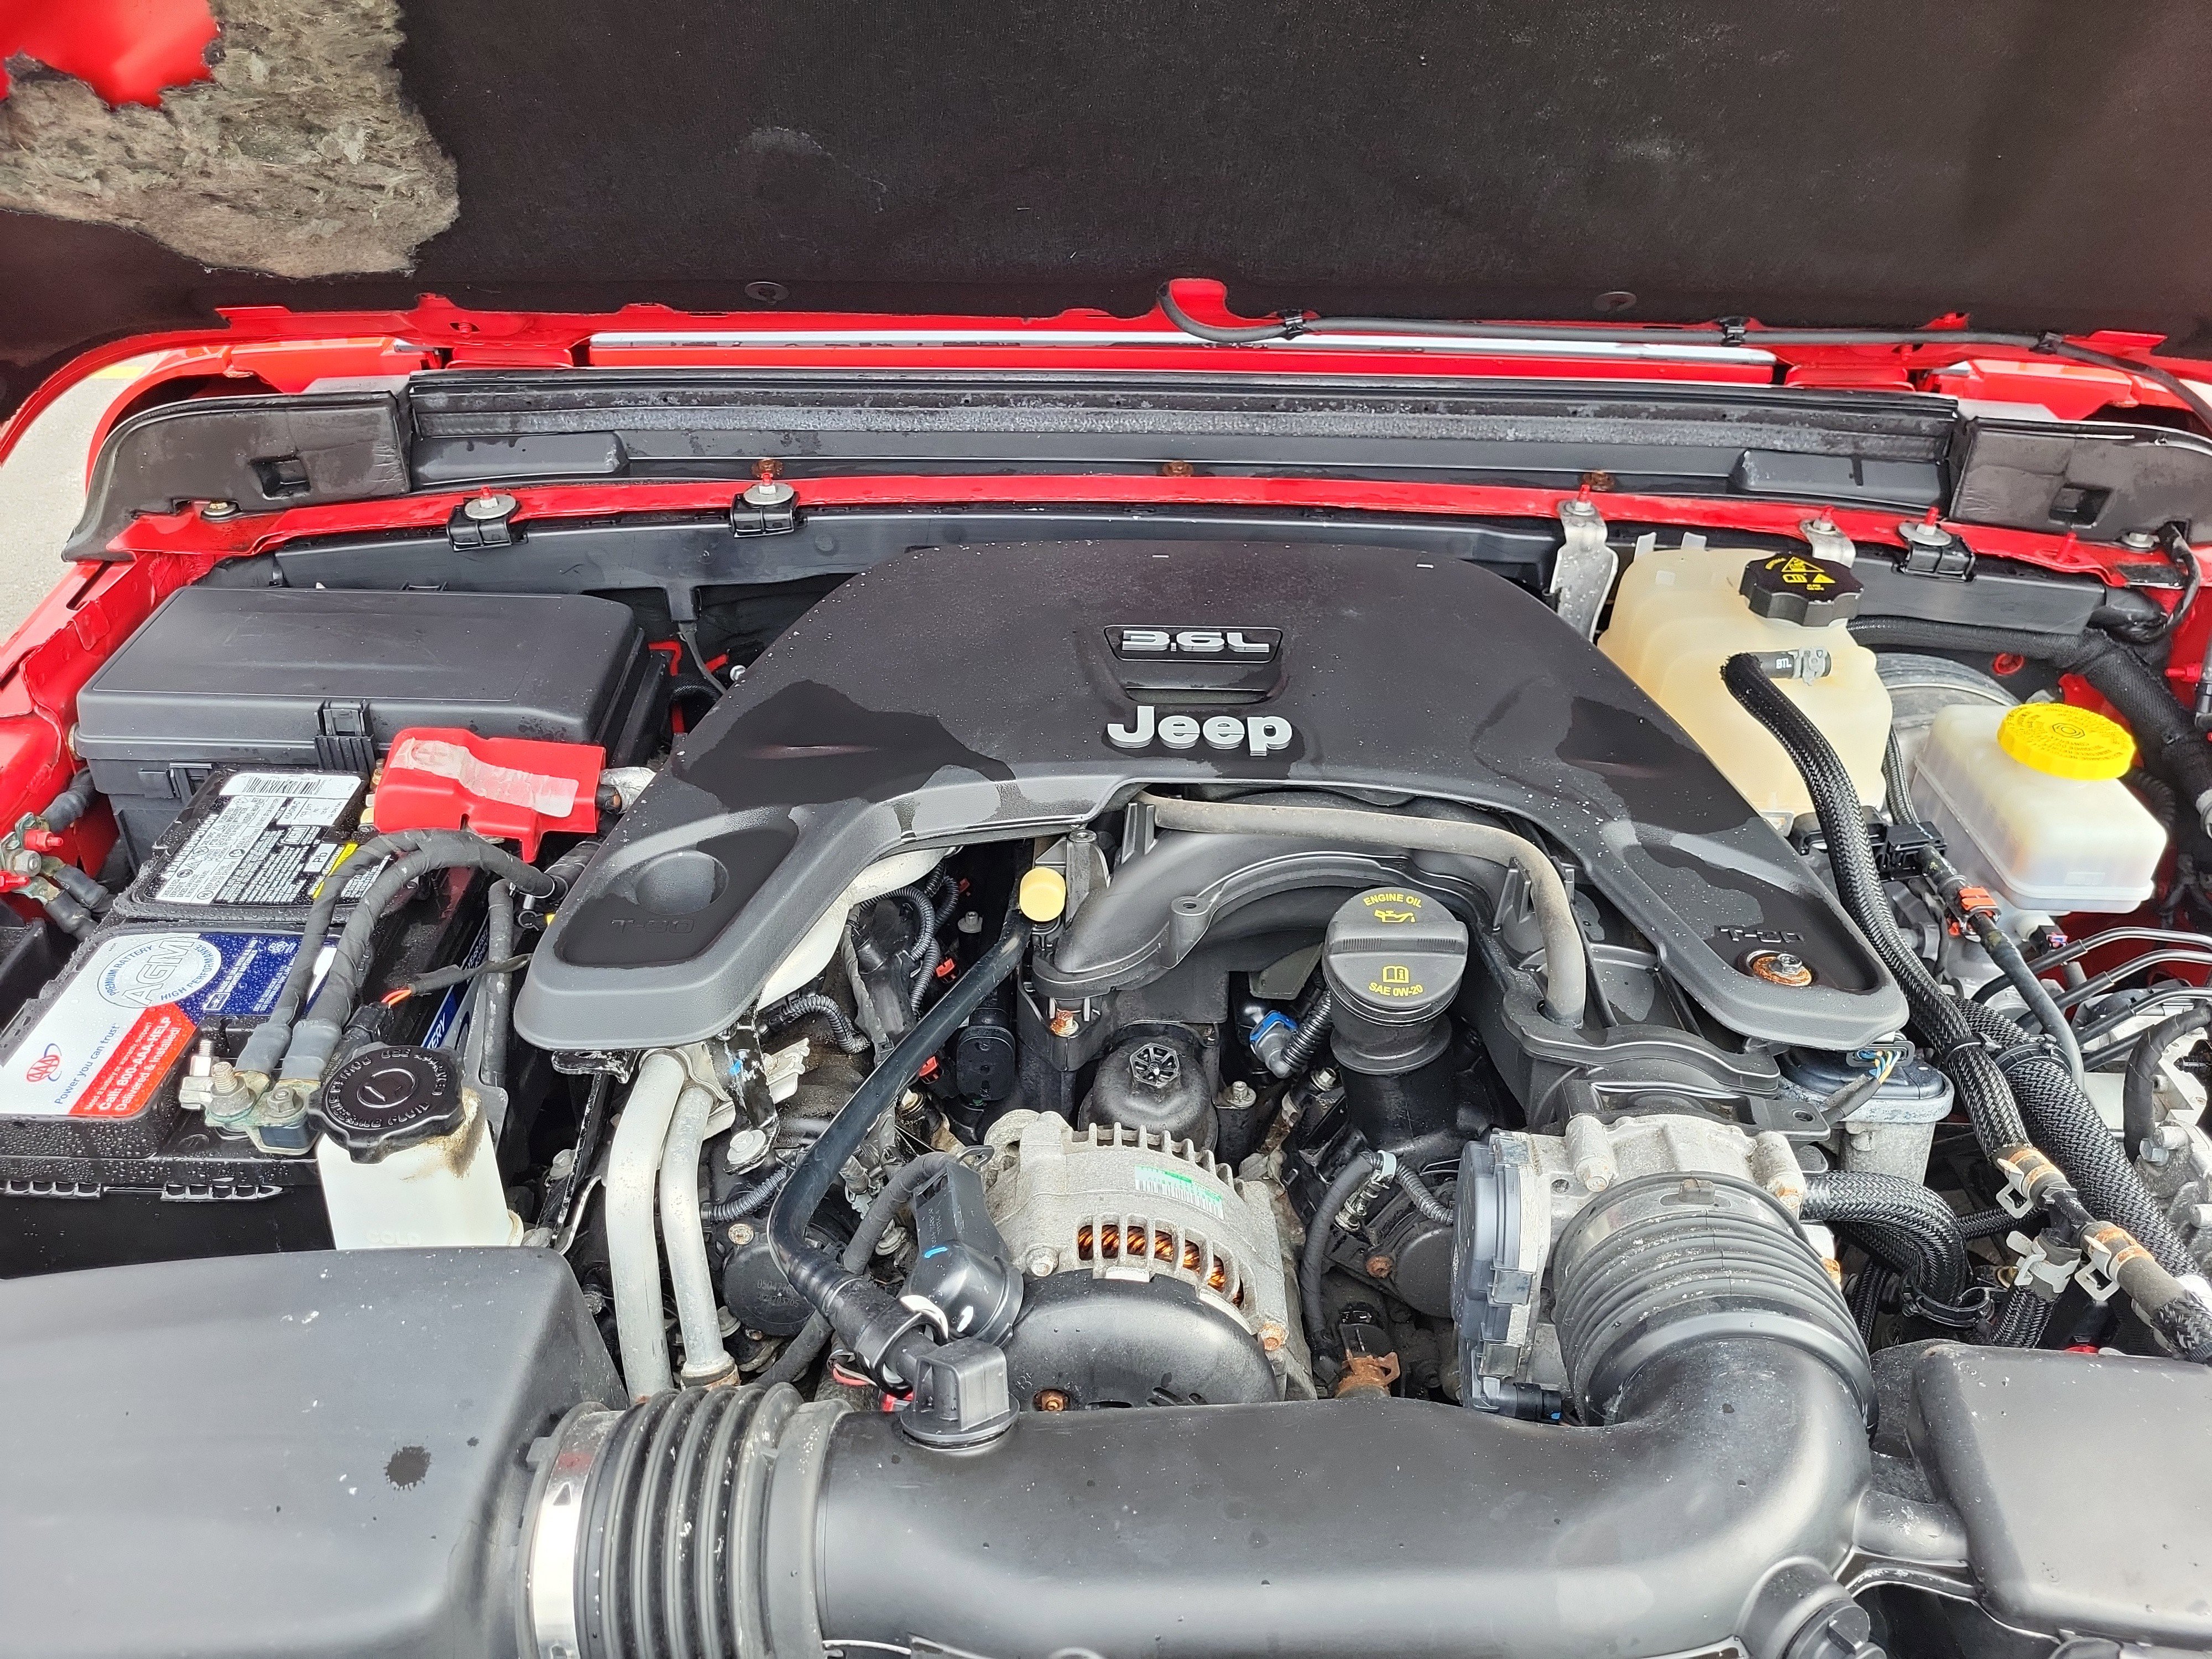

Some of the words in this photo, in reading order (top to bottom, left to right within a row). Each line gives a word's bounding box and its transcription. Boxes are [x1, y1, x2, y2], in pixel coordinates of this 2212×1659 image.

[1122, 630, 1270, 653] 3.6L
[1776, 658, 1792, 669] BTL
[1107, 706, 1293, 756] Jeep
[285, 827, 306, 843] AGM
[312, 852, 328, 863] Pb
[1363, 893, 1404, 906] ENGINE
[1406, 896, 1422, 908] OIL
[105, 969, 120, 996] PREMIUM
[113, 945, 153, 968] BATTERY
[122, 940, 195, 1006] AGM
[161, 987, 187, 1001] HIGH
[187, 944, 215, 988] PERFORMANCE
[1368, 982, 1391, 996] SAE
[1392, 984, 1423, 997] 0W-20
[28, 1056, 60, 1079] AAA
[54, 1078, 78, 1104] Power
[79, 1061, 93, 1077] you
[91, 1047, 102, 1060] can
[100, 1024, 121, 1045] trust
[100, 1088, 122, 1109] Call:
[117, 1017, 172, 1086] 800-AAA-HELP
[116, 1072, 148, 1110] Delivered
[152, 1027, 181, 1062] Installed!
